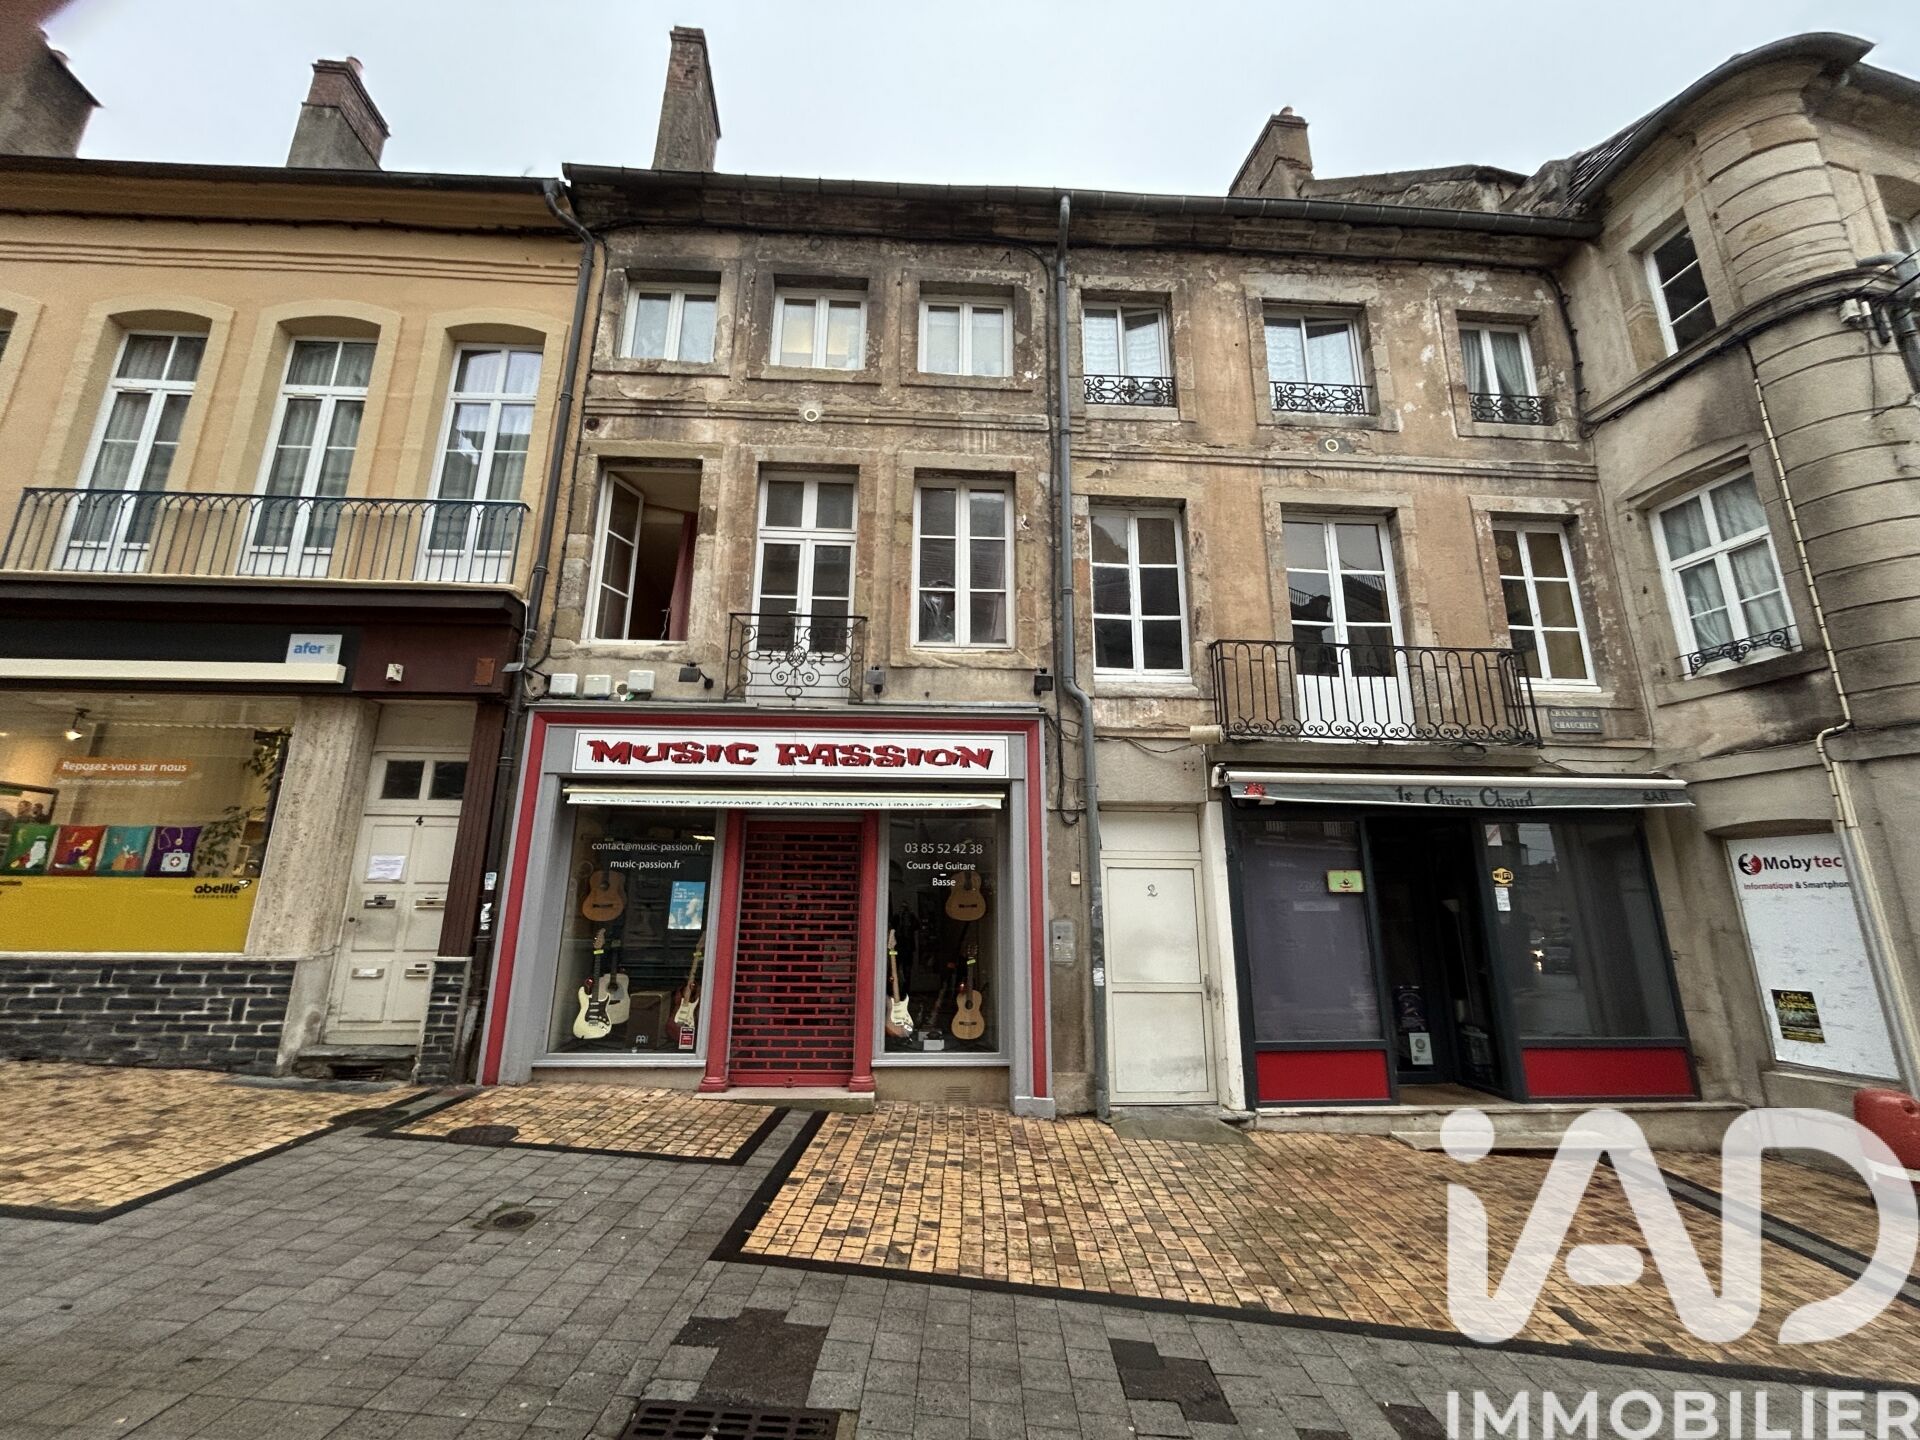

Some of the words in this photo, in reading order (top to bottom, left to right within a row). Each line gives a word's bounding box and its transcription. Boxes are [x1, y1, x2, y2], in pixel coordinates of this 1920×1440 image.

[293, 642, 325, 654] afer
[587, 740, 759, 765] MUSIC
[775, 743, 994, 770] PASSION
[62, 761, 137, 773] Reposez-vous
[139, 763, 158, 772] sur
[160, 763, 187, 772] nous
[1424, 786, 1473, 806] Chien
[1480, 786, 1537, 807] Chaud
[415, 816, 424, 826] 4
[592, 841, 702, 852] contact@music-passion.fr
[904, 842, 919, 854] 03
[920, 843, 935, 854] 85
[937, 843, 951, 854] 52
[952, 843, 967, 854] 42
[969, 844, 983, 854] 38
[610, 859, 681, 870] music-passion.fr
[906, 861, 931, 870] Cours
[932, 861, 944, 870] de
[945, 861, 976, 871] Guitare
[932, 877, 957, 887] Basse
[1795, 881, 1802, 889] &
[1147, 884, 1159, 897] 2
